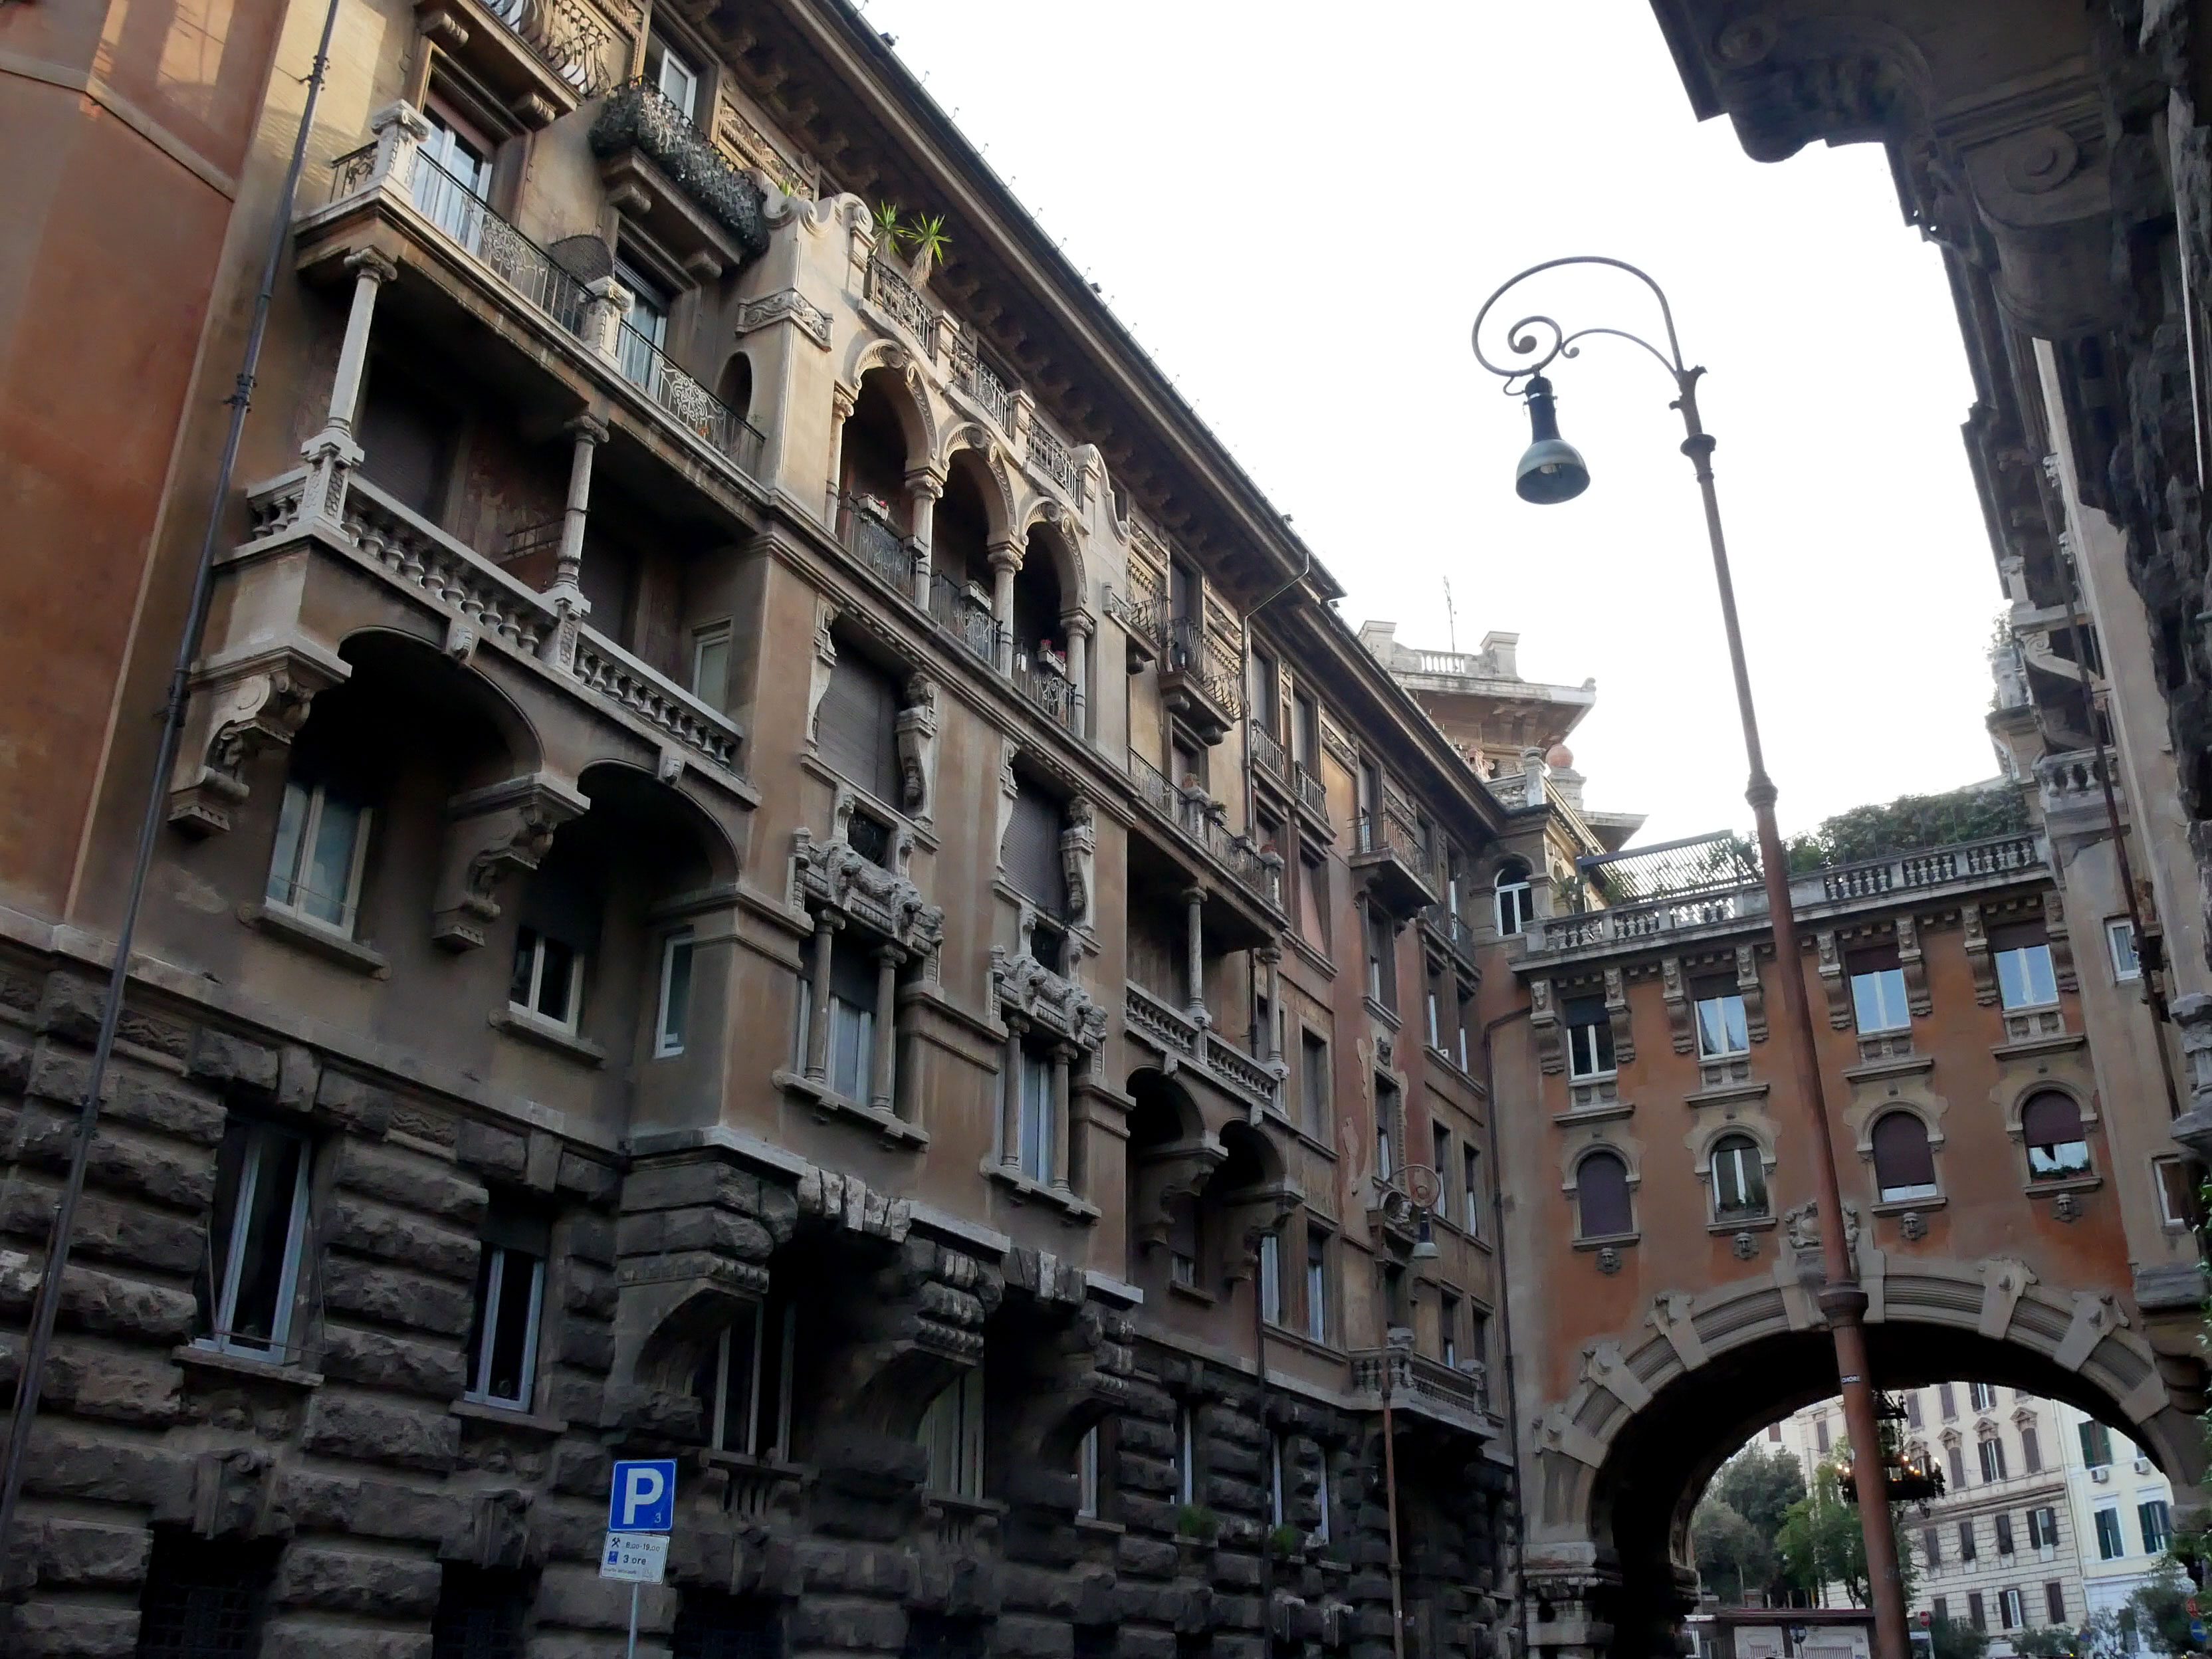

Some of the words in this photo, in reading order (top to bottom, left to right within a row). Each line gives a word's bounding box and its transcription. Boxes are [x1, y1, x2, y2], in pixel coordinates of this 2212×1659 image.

[623, 1468, 664, 1525] P
[654, 1511, 661, 1523] 3
[623, 1554, 629, 1564] 3
[631, 1557, 647, 1566] ore
